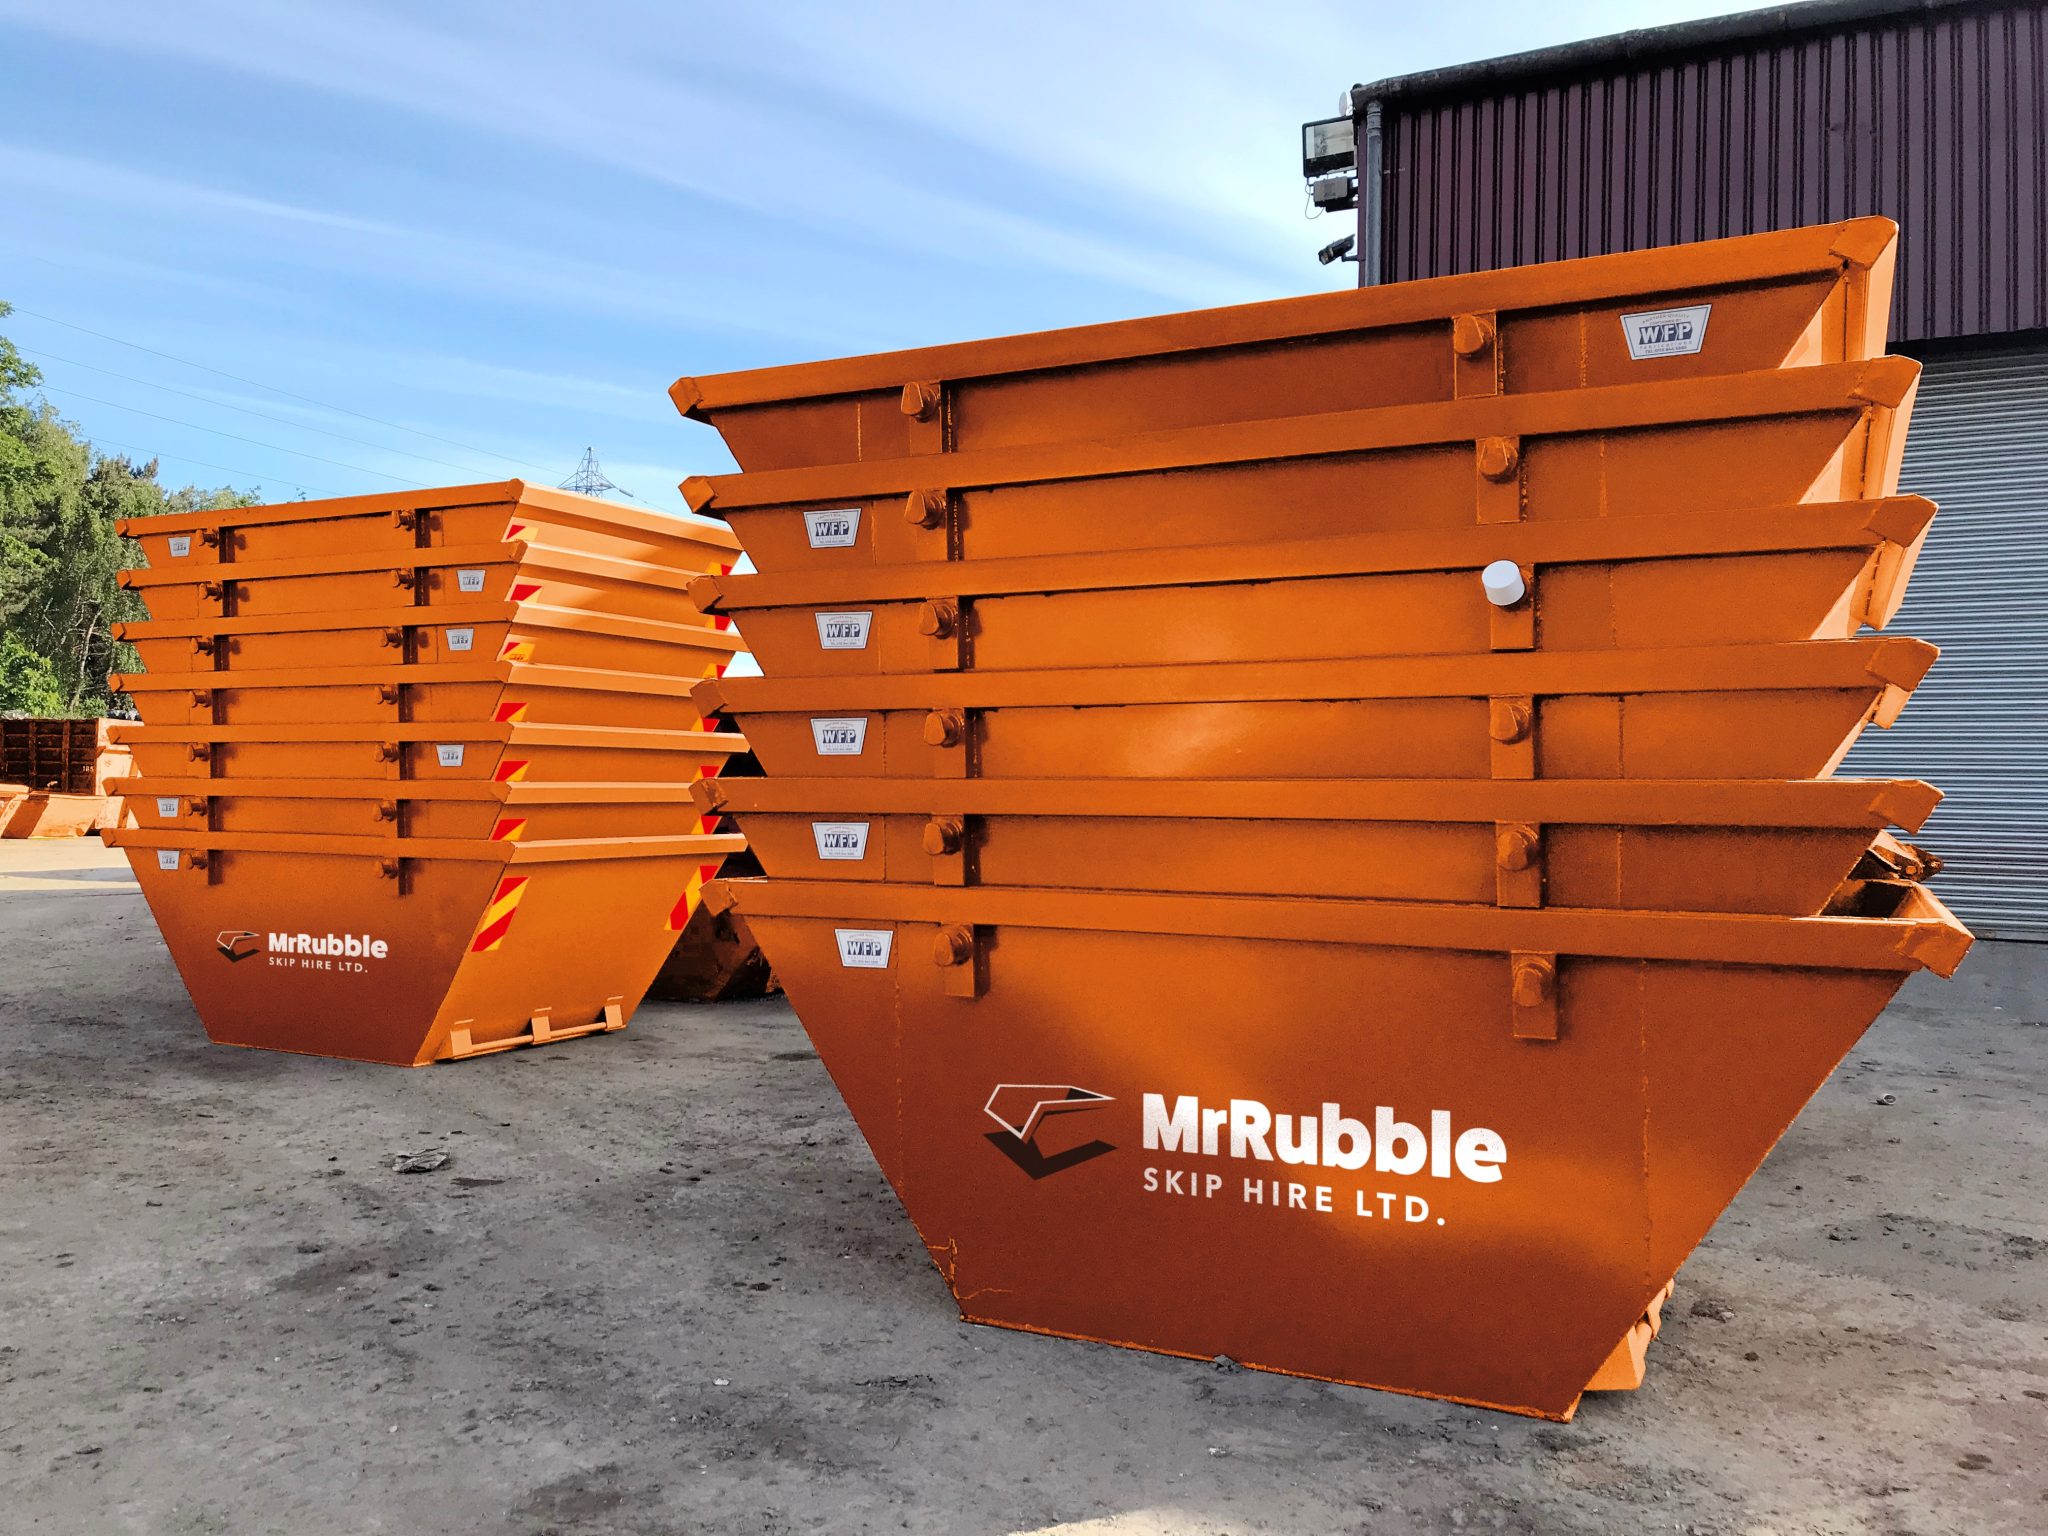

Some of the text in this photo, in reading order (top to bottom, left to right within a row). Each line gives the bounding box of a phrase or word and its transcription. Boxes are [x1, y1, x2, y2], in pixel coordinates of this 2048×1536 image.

[1640, 322, 1692, 344] WFP
[816, 521, 849, 536] WFP
[827, 623, 861, 638] WFP
[823, 729, 856, 744] WFP
[825, 833, 858, 849] WFP
[268, 932, 389, 959] MrRubble
[847, 940, 882, 957] WFP
[268, 956, 369, 973] SKIP HIRE LTD.
[1142, 1092, 1508, 1184] MrRubble
[1143, 1166, 1446, 1227] SKIP HIRE LTD.
